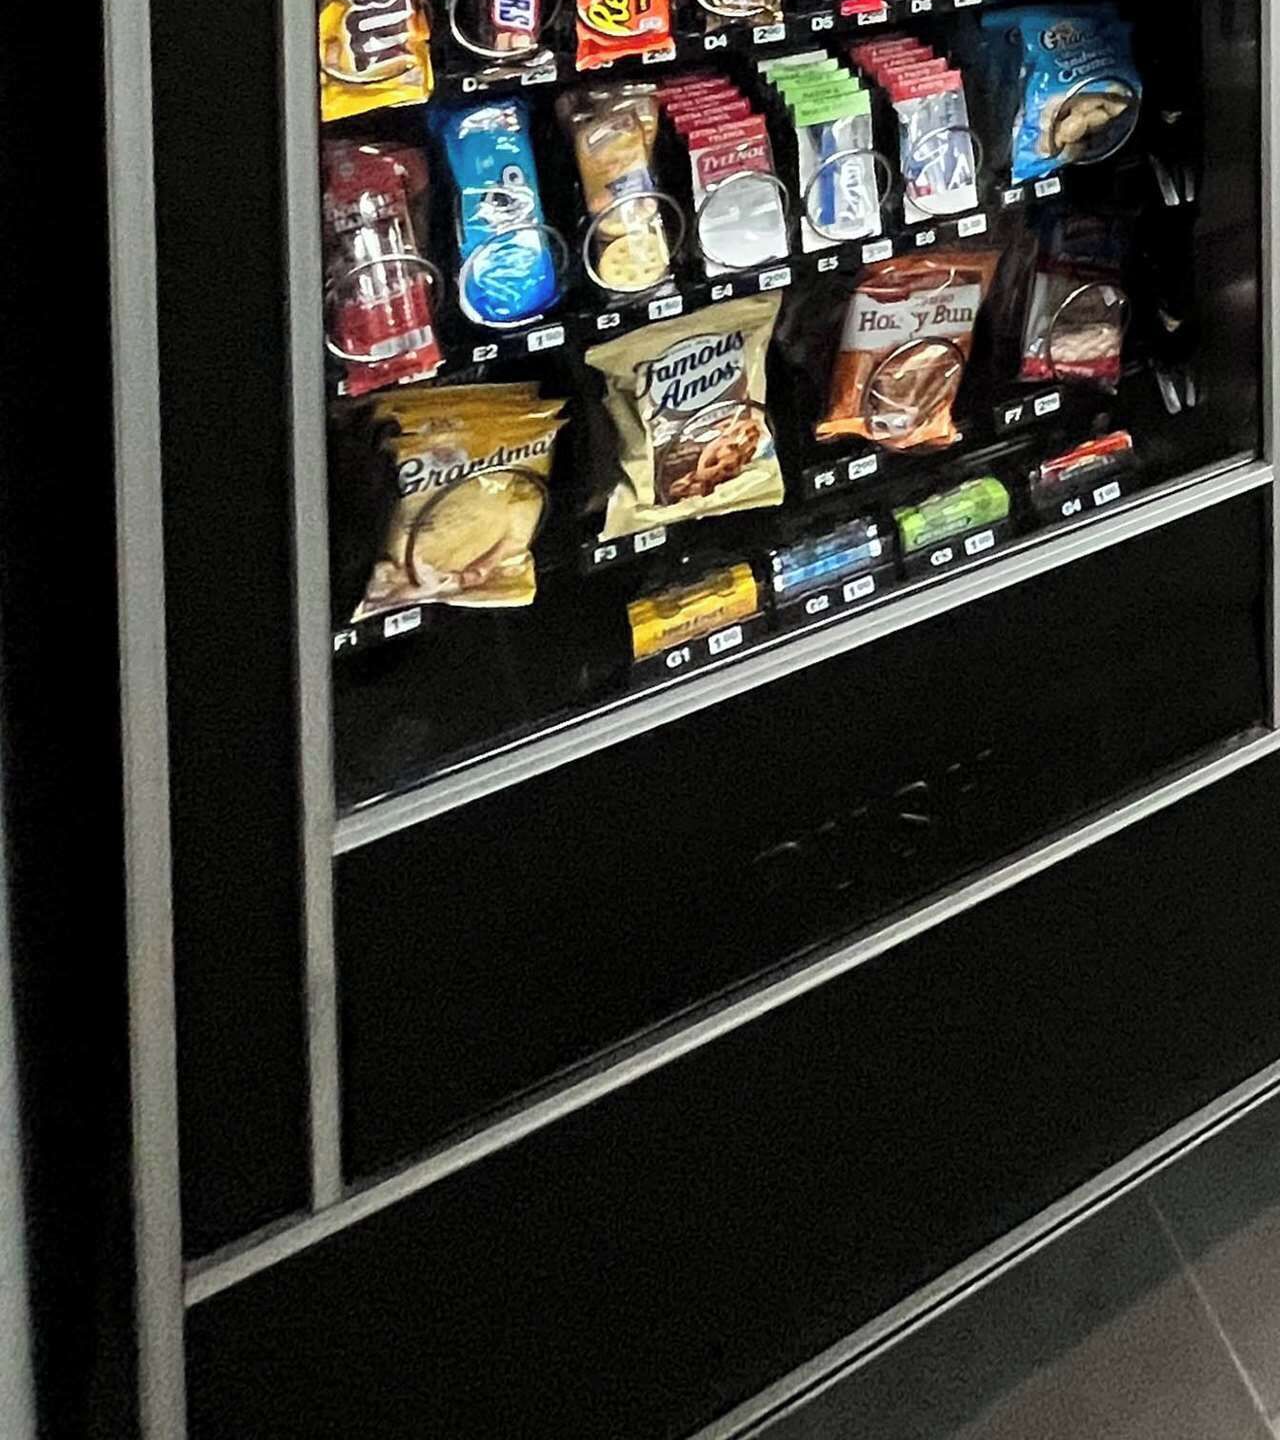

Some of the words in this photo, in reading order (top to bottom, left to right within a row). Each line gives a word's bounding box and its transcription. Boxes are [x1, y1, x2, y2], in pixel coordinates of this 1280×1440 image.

[704, 35, 728, 50] D4
[817, 256, 839, 272] E5
[711, 283, 733, 300] E4
[597, 312, 621, 329] E3
[858, 310, 931, 333] Hoy
[932, 304, 973, 325] Bun
[472, 344, 499, 362] E2
[633, 330, 745, 400] Famous
[647, 360, 739, 421] Amos
[333, 630, 358, 651] F1
[666, 648, 690, 668] G1
